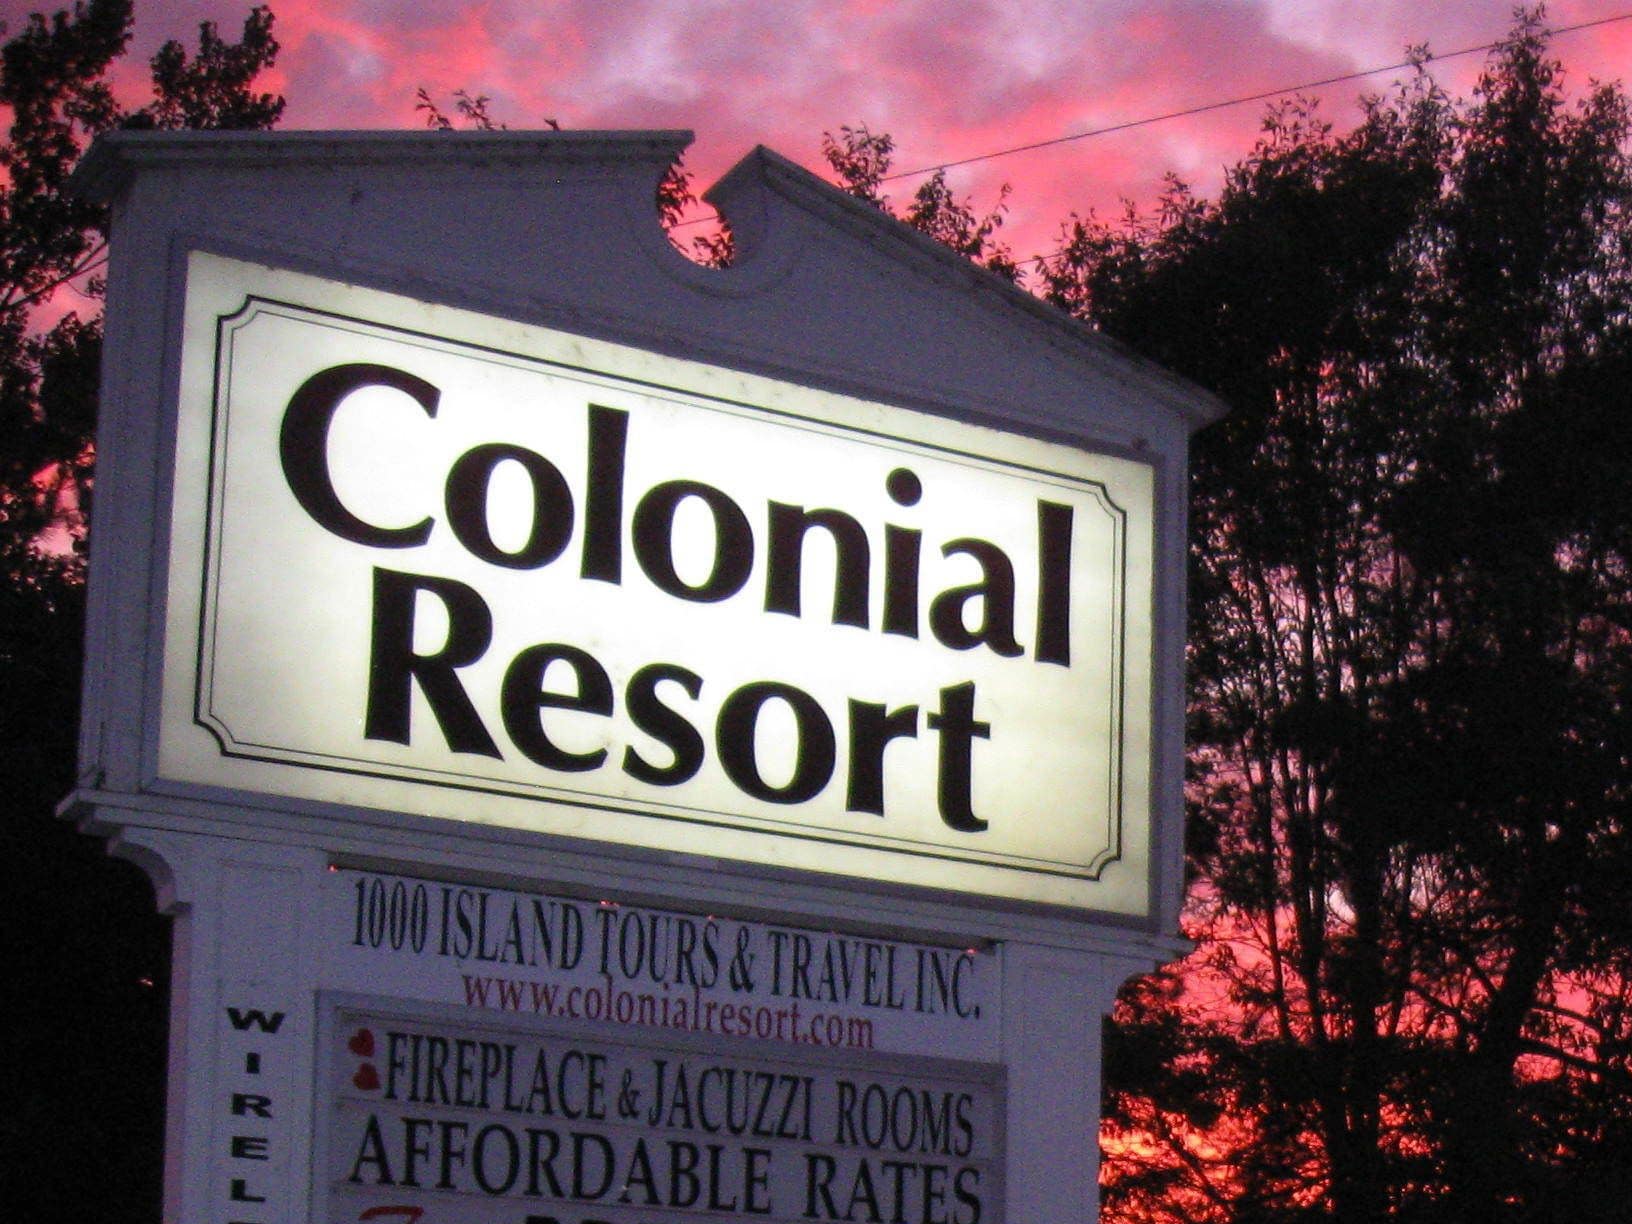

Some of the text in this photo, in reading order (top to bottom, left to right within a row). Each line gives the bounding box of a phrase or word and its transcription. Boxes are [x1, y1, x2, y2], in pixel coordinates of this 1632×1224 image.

[278, 362, 1075, 668] Colonial
[364, 565, 990, 833] Resort
[352, 878, 980, 1020] 1000 ISLAND TOURS & TRAVEL INC.
[462, 974, 874, 1049] www.colonialresort.com
[385, 1032, 973, 1157] FIREPLACE & JACUZZI ROOMS
[349, 1113, 771, 1215] AFFORDABLE
